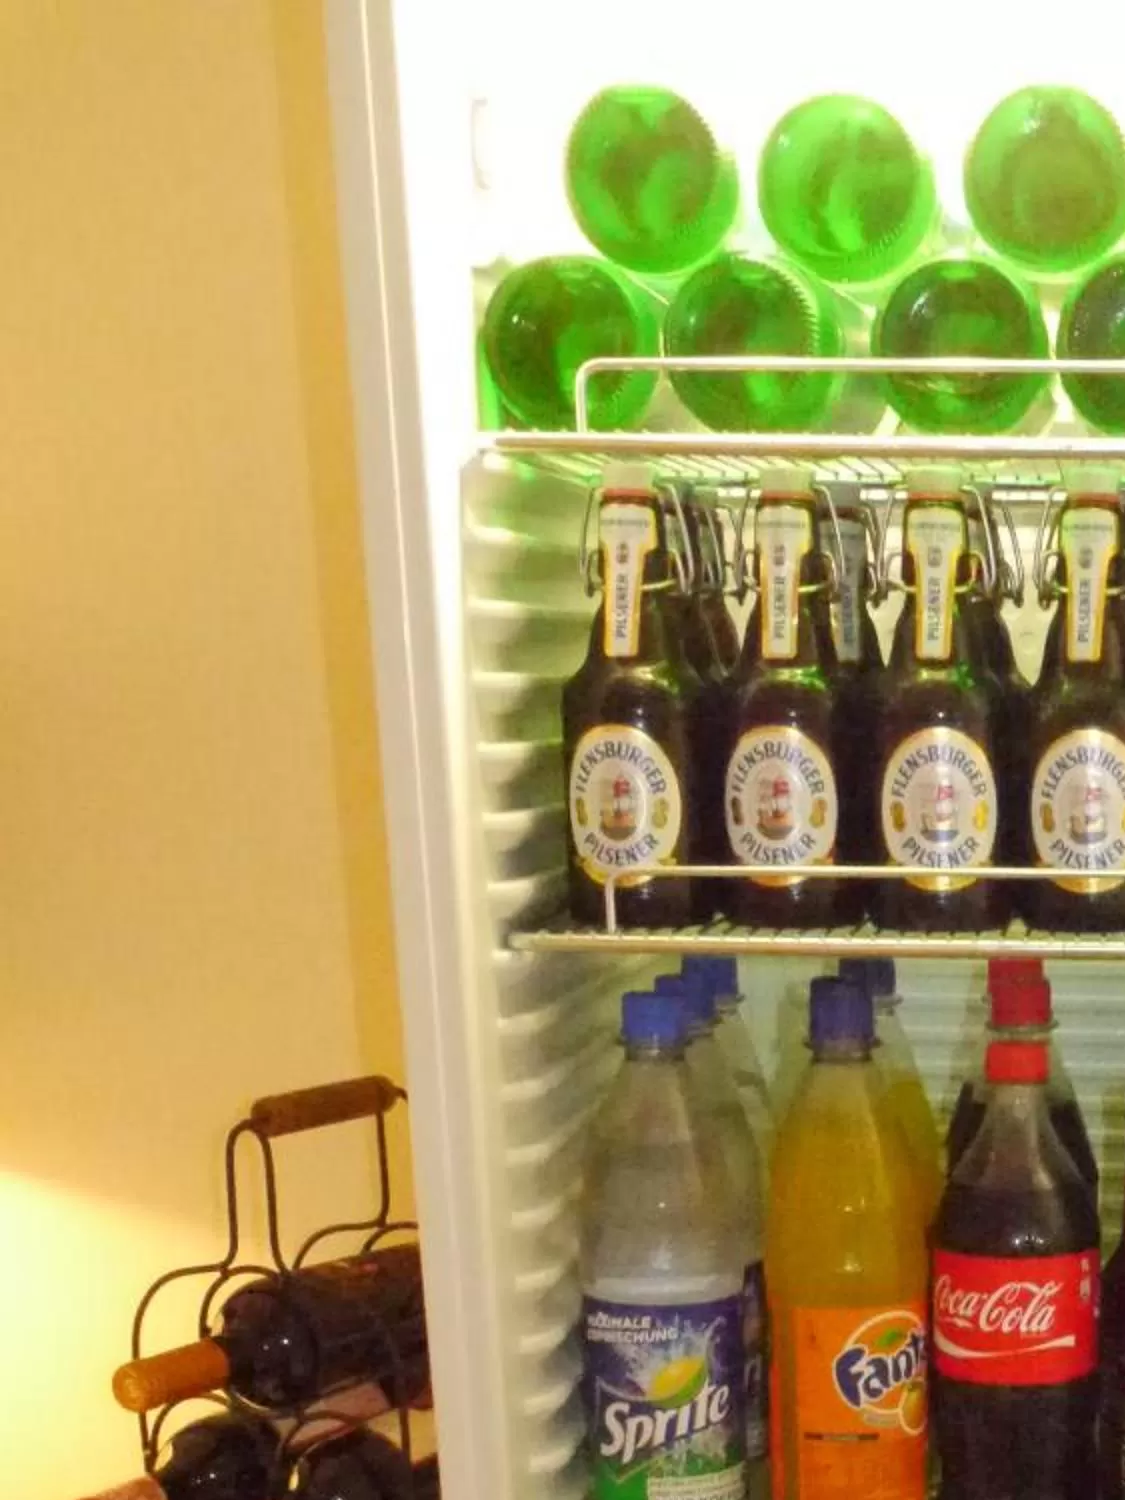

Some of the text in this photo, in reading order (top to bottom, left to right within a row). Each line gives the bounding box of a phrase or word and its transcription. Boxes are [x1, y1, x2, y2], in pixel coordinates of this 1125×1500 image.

[576, 741, 667, 795] FLENSBURGER
[733, 741, 825, 795] FLENSBURGER
[892, 743, 986, 799] FLENSBURGER
[584, 833, 659, 867] PILSENER
[740, 833, 818, 867] PILSENER
[902, 835, 981, 868] PILSENER
[934, 1274, 1064, 1335] Coca-Cola
[833, 1326, 927, 1409] Fant
[600, 1376, 730, 1465] Sprite
